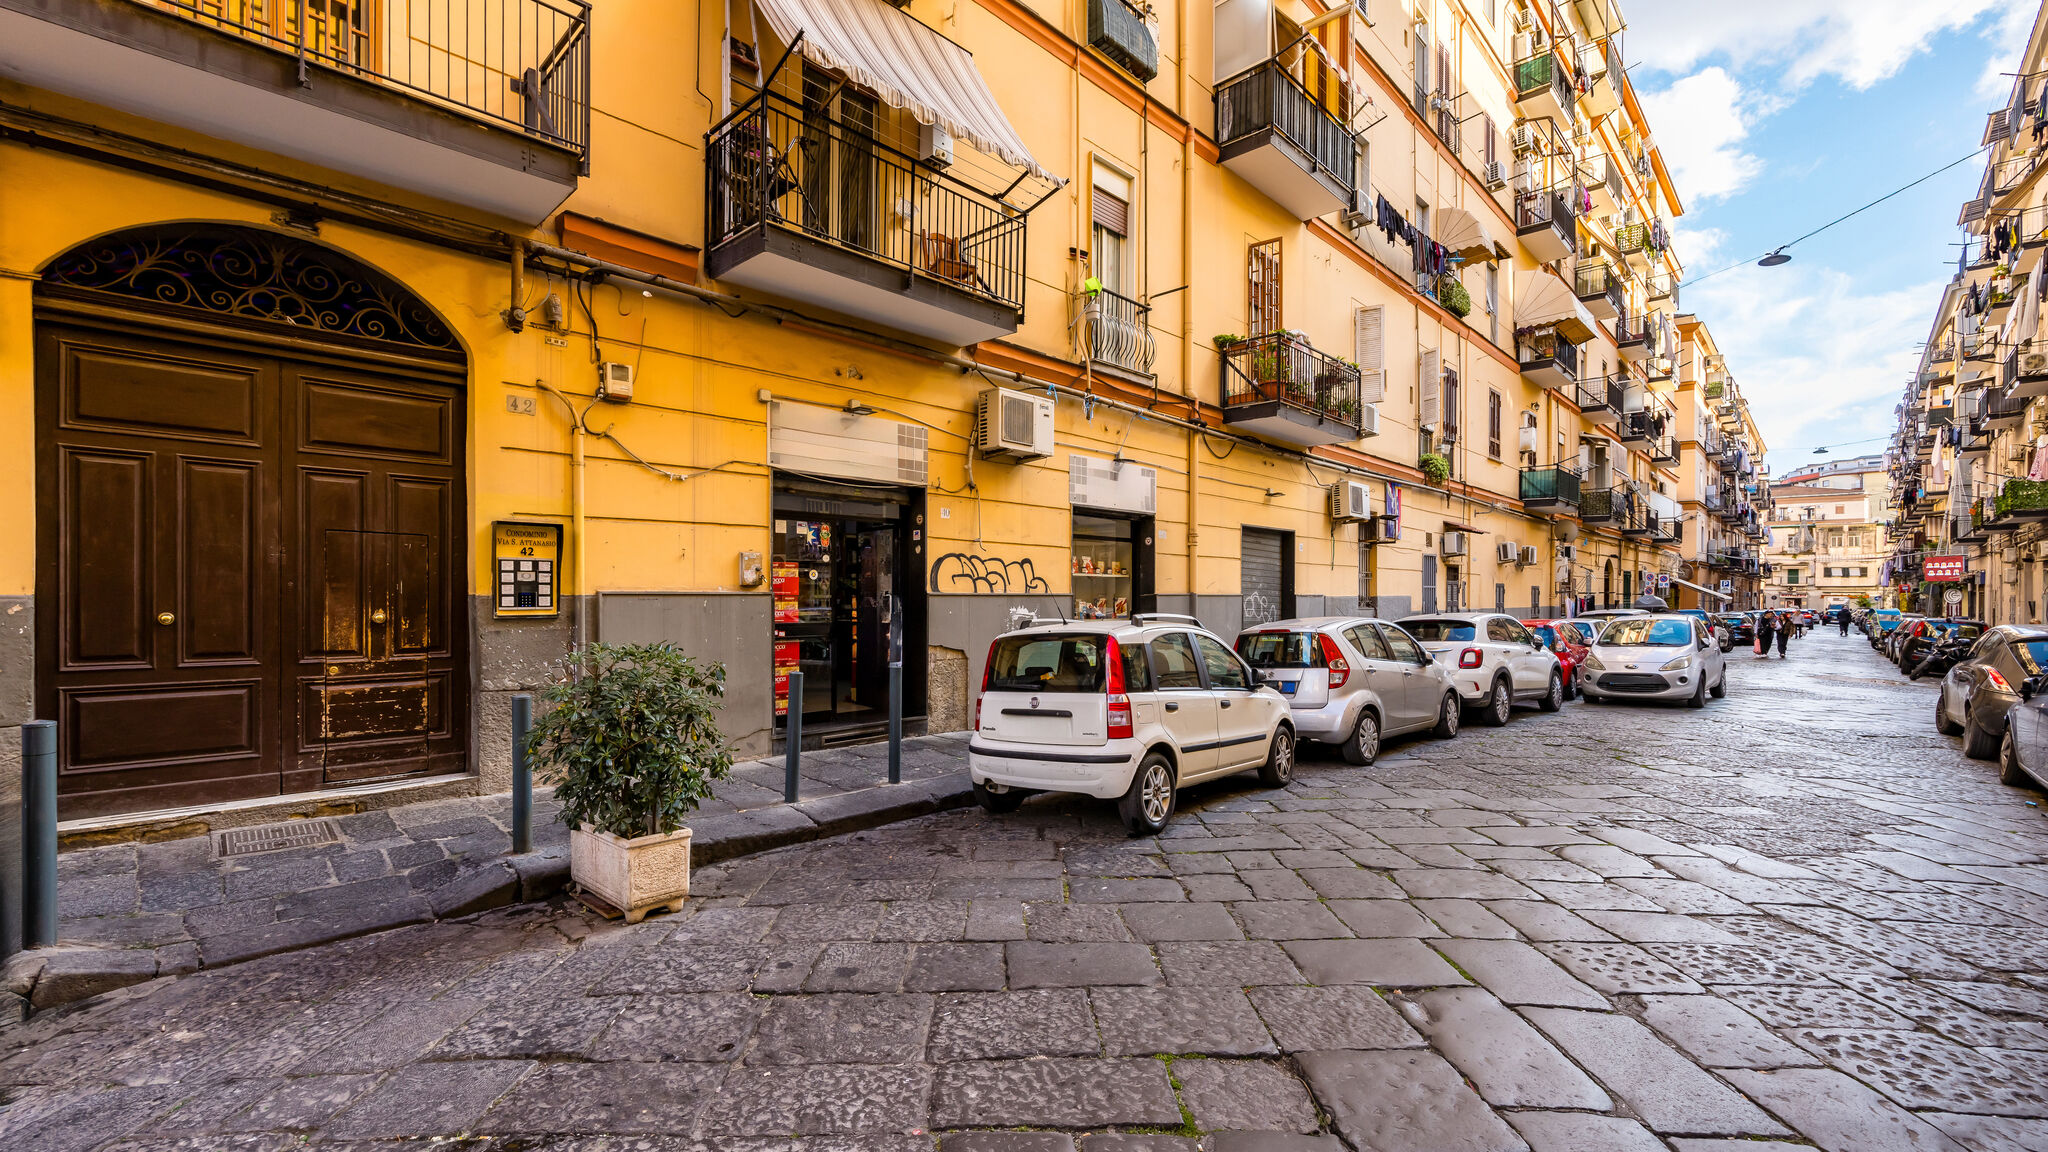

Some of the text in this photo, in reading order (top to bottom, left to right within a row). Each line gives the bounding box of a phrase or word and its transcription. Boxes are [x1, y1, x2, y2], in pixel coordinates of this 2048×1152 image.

[511, 397, 532, 413] 42
[506, 529, 548, 538] CONDOMINIO
[520, 547, 534, 556] 42
